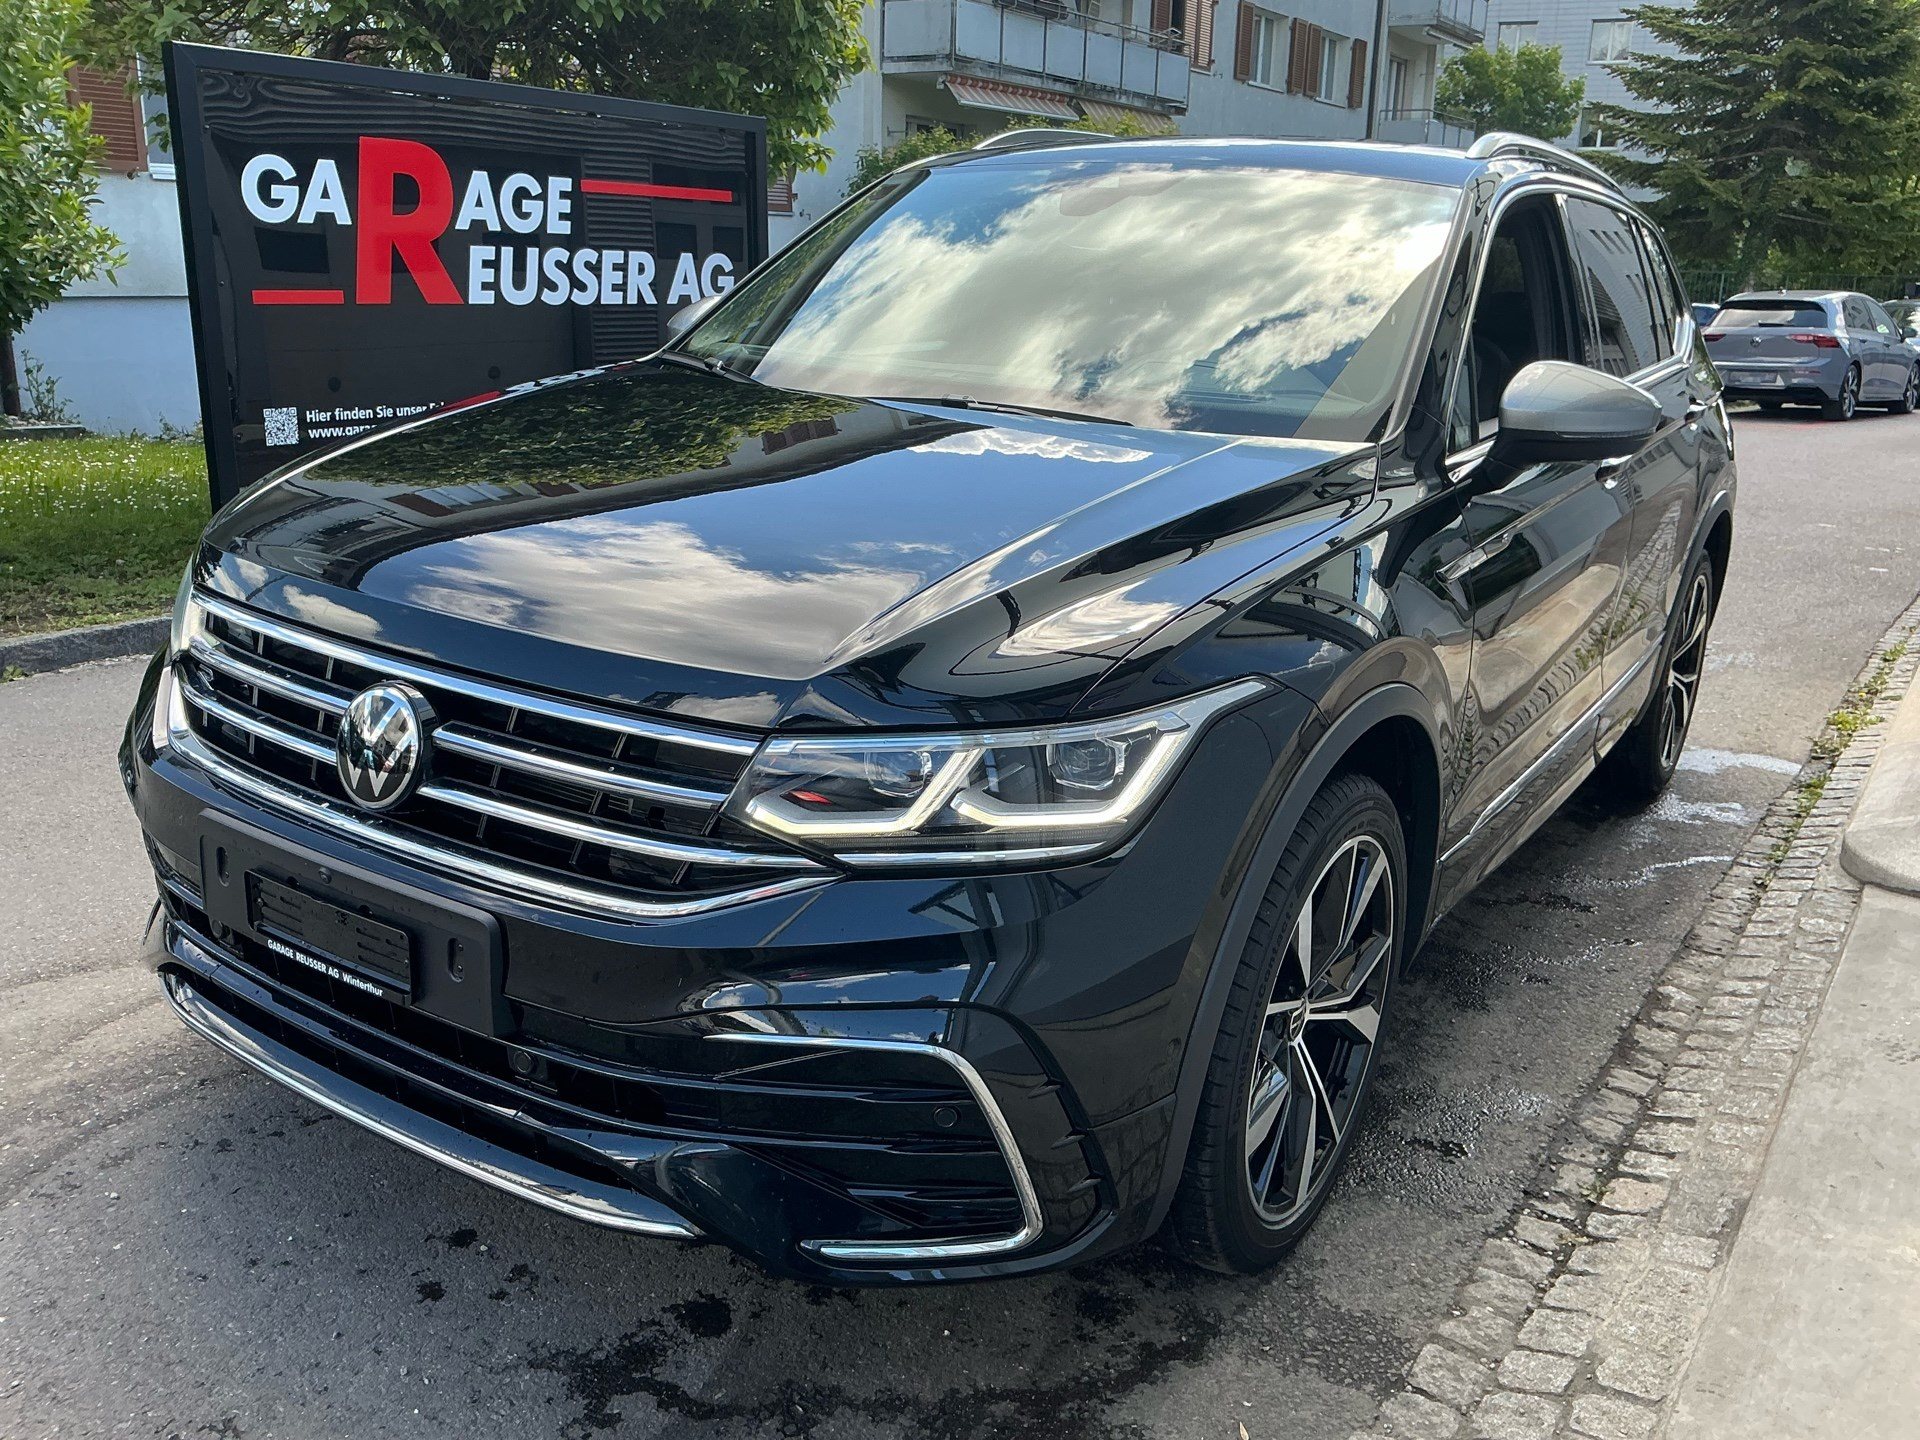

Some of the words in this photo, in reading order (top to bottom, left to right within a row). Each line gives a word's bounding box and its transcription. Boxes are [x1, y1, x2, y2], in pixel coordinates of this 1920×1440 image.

[241, 136, 572, 304] GARAGE
[666, 252, 735, 304] AG
[306, 410, 331, 423] Hier
[335, 408, 373, 421] finden
[376, 406, 394, 418] Sie
[267, 939, 294, 959] GARAGE
[295, 952, 327, 974] REUSSER
[328, 966, 340, 979] AG
[342, 972, 384, 997] Winterthur
